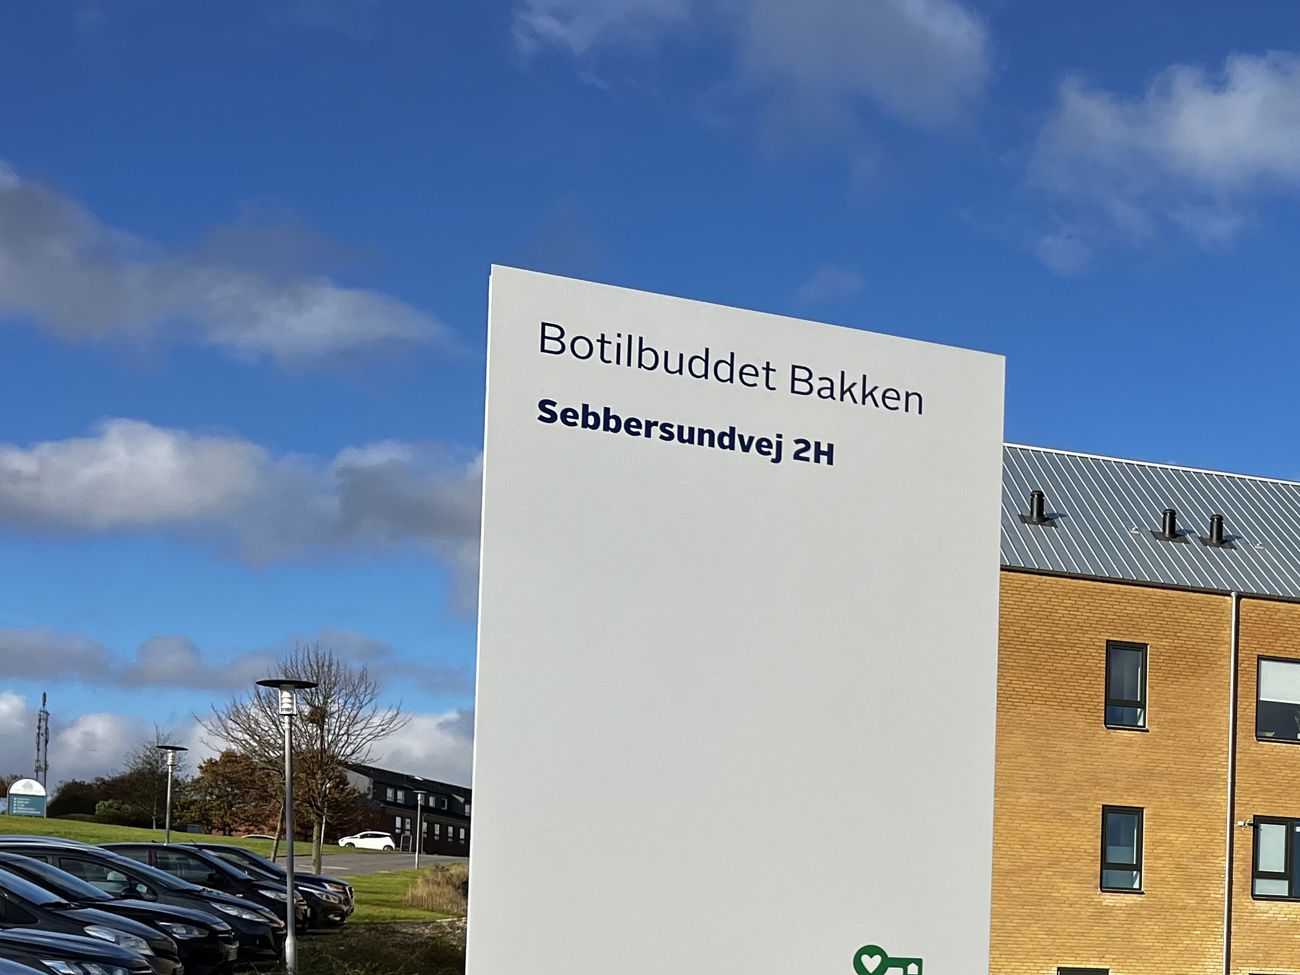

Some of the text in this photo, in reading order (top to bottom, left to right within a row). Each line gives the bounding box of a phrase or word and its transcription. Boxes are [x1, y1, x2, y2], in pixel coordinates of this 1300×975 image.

[539, 321, 925, 415] Botilbuddet Bakken
[537, 398, 835, 466] Sebbersundvej 2H
